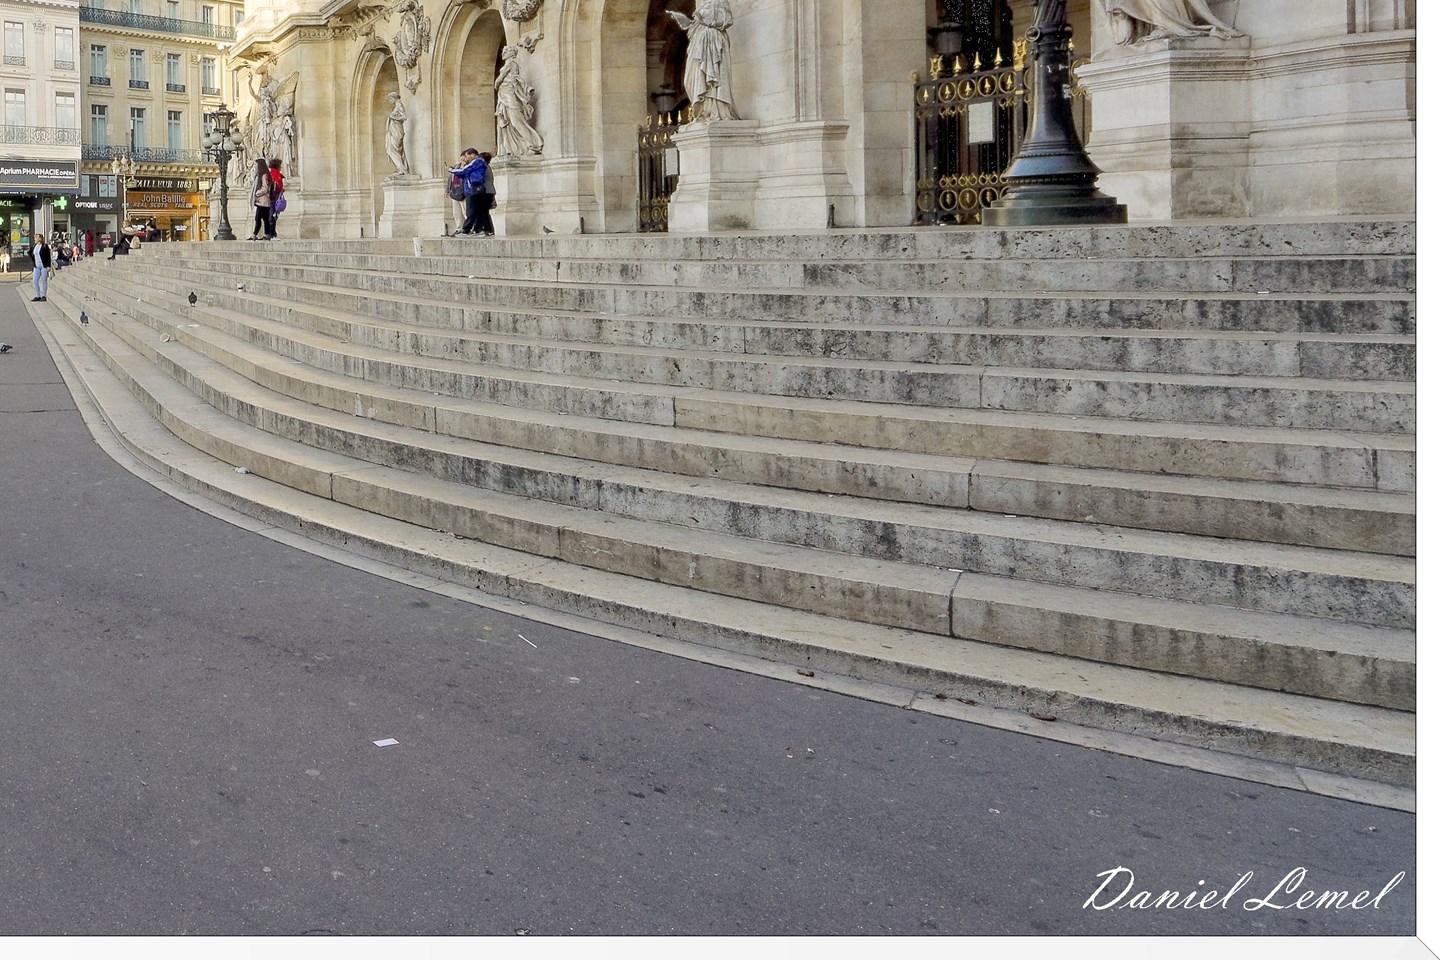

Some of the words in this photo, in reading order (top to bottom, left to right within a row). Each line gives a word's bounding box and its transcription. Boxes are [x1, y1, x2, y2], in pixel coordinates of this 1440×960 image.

[0, 167, 22, 176] Aprium
[177, 180, 193, 189] 1883
[141, 194, 161, 203] John
